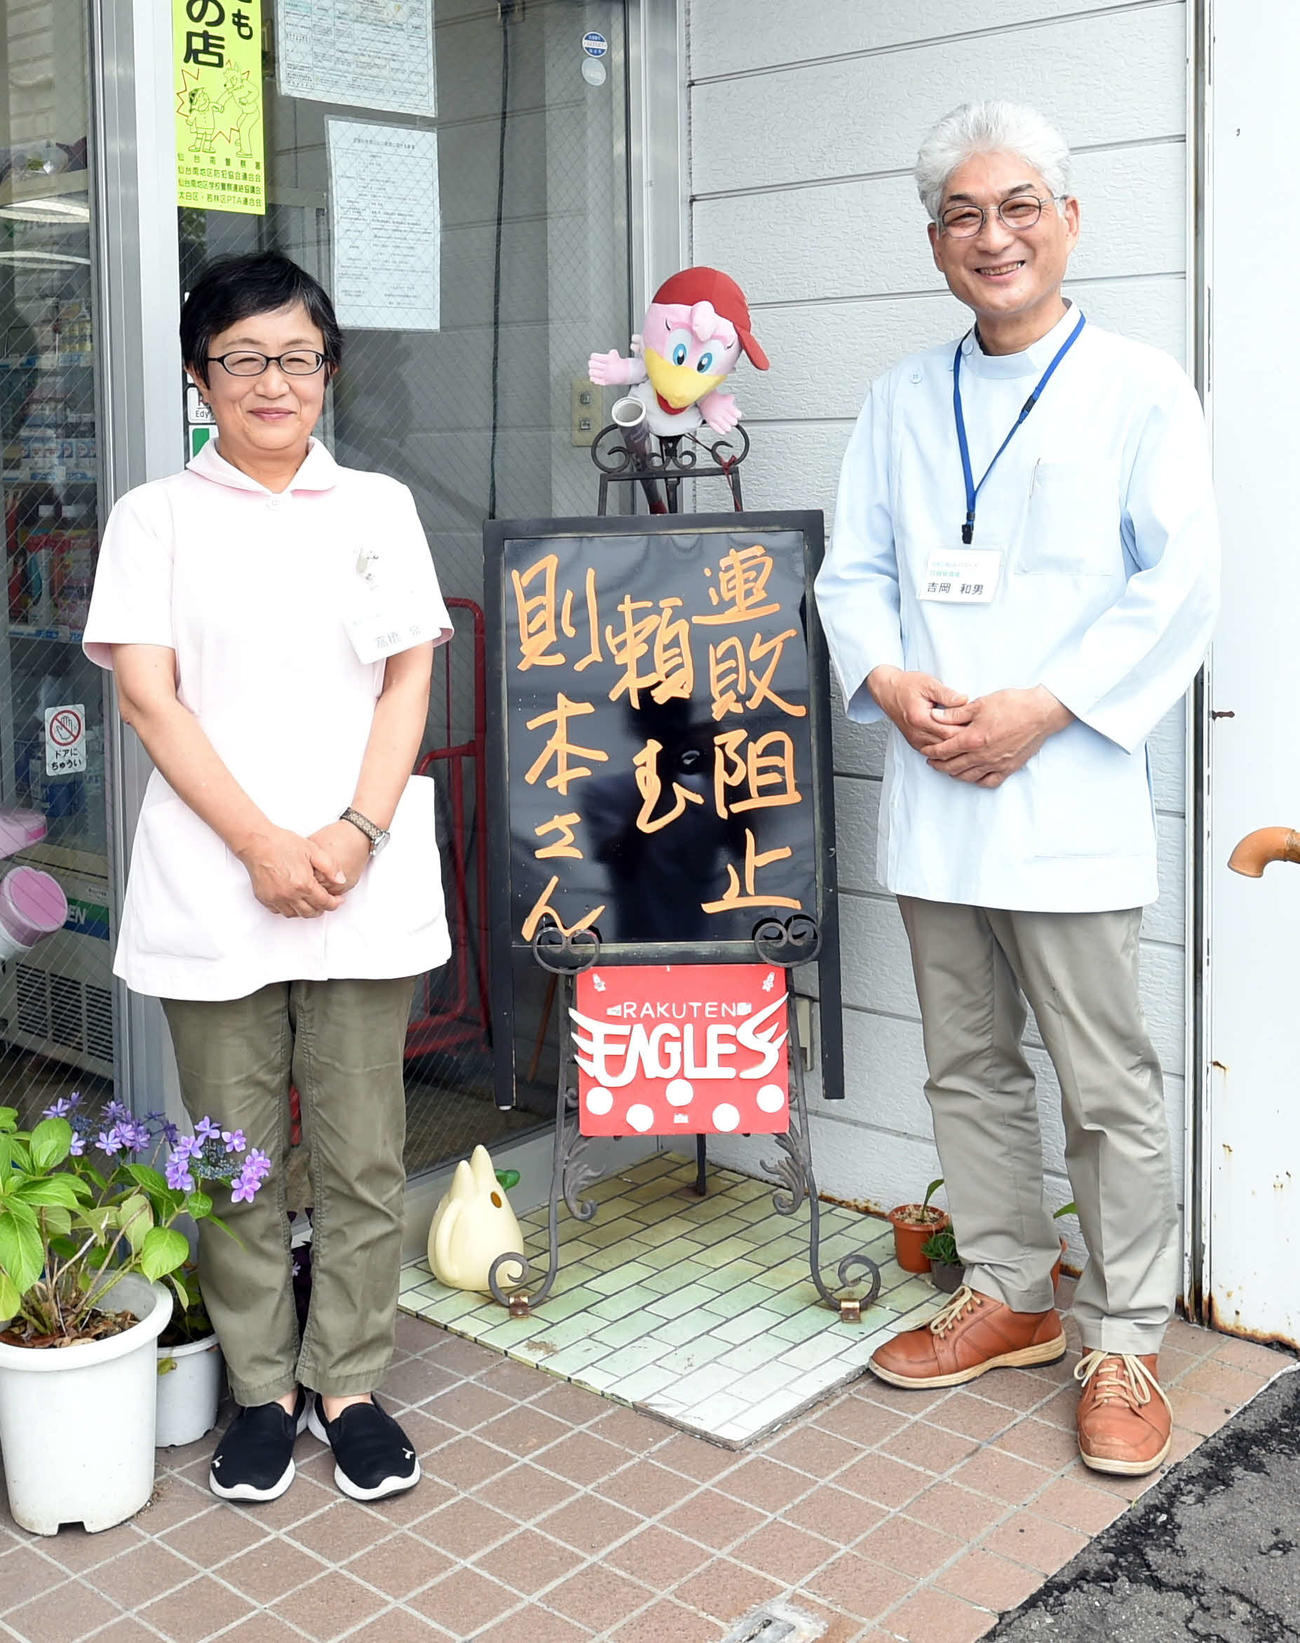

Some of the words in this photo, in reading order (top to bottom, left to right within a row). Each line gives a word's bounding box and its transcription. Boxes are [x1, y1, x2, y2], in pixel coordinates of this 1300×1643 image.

[183, 0, 225, 68] の店
[232, 0, 253, 40] も
[195, 410, 210, 419] Edy
[927, 582, 952, 594] 吉岡
[960, 583, 984, 596] 和男
[692, 544, 807, 914] 連敗阻止
[55, 748, 78, 759] ドアに
[511, 553, 610, 942] 則本さん
[51, 758, 82, 771] ちゅうい
[623, 1001, 737, 1019] RAKUTEN
[568, 991, 790, 1088] EAGLES
